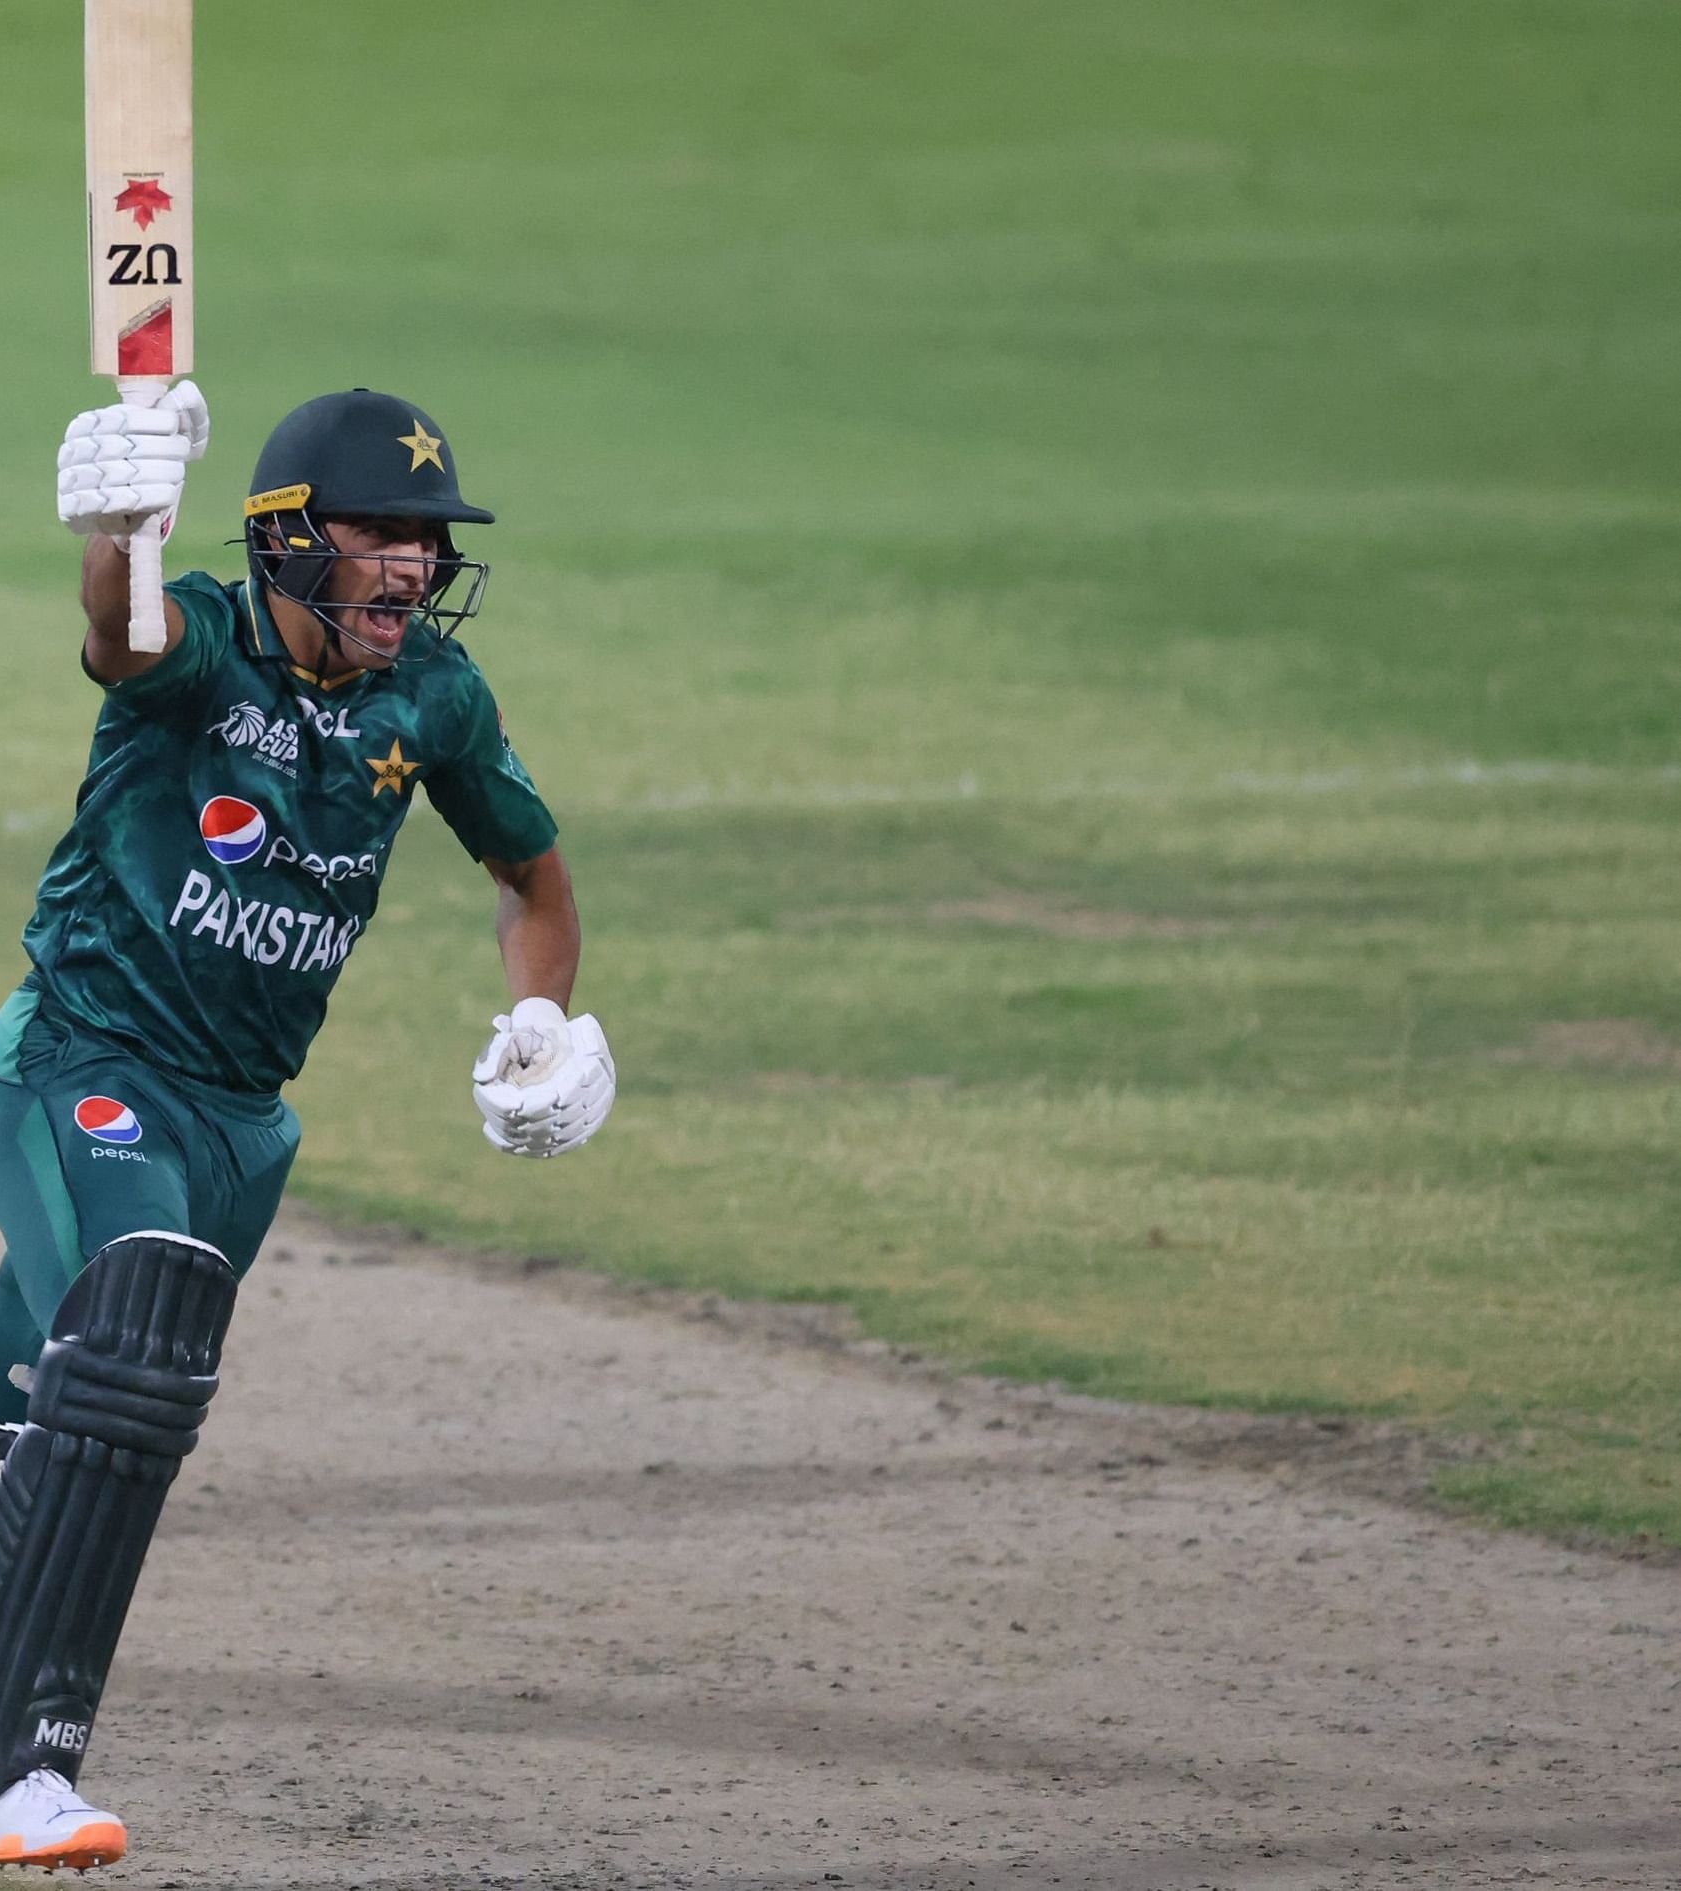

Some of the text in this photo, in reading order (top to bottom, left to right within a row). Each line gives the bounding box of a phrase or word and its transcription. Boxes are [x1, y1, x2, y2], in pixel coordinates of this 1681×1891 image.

[106, 243, 182, 284] UZ
[262, 490, 298, 504] MASURI
[257, 734, 299, 762] CUP
[169, 869, 359, 971] PAKISTAN
[91, 1147, 146, 1162] pepsi
[34, 1718, 87, 1750] MBS
